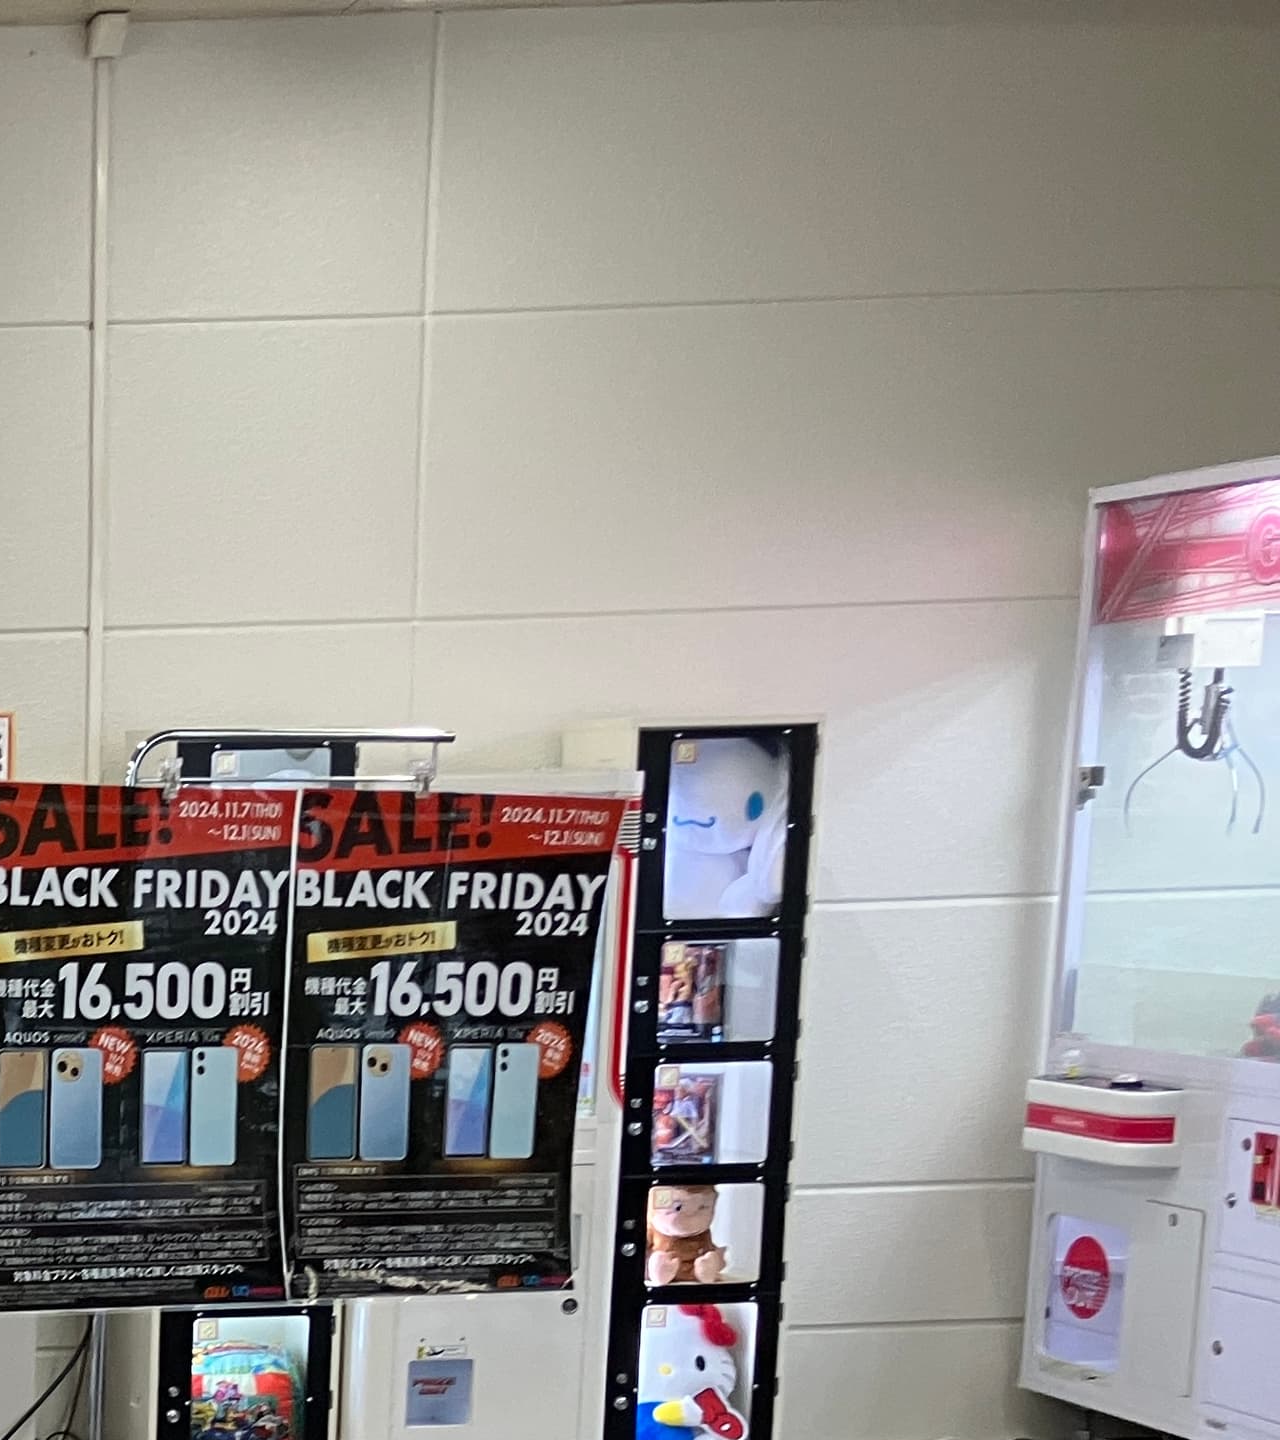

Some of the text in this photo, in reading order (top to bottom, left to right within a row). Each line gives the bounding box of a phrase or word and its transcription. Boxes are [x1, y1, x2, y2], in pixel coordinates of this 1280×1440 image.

[296, 789, 496, 864] SALE!
[132, 868, 291, 909] FRIDAY
[296, 869, 608, 912] BLACK FRIDAY
[203, 908, 279, 937] 2024
[515, 911, 589, 937] 2024
[57, 960, 227, 1021] 16,500
[229, 967, 252, 991] 円
[304, 960, 560, 1018] 機種代金 16,500 円
[21, 991, 269, 1019] 最大 割引
[333, 991, 575, 1016] 最大 割引
[3, 1030, 50, 1044] AQUOS
[97, 1033, 134, 1054] NEW
[146, 1030, 200, 1044] XPERIA
[315, 1027, 360, 1040] AQUOS
[452, 1027, 504, 1040] XPERIA
